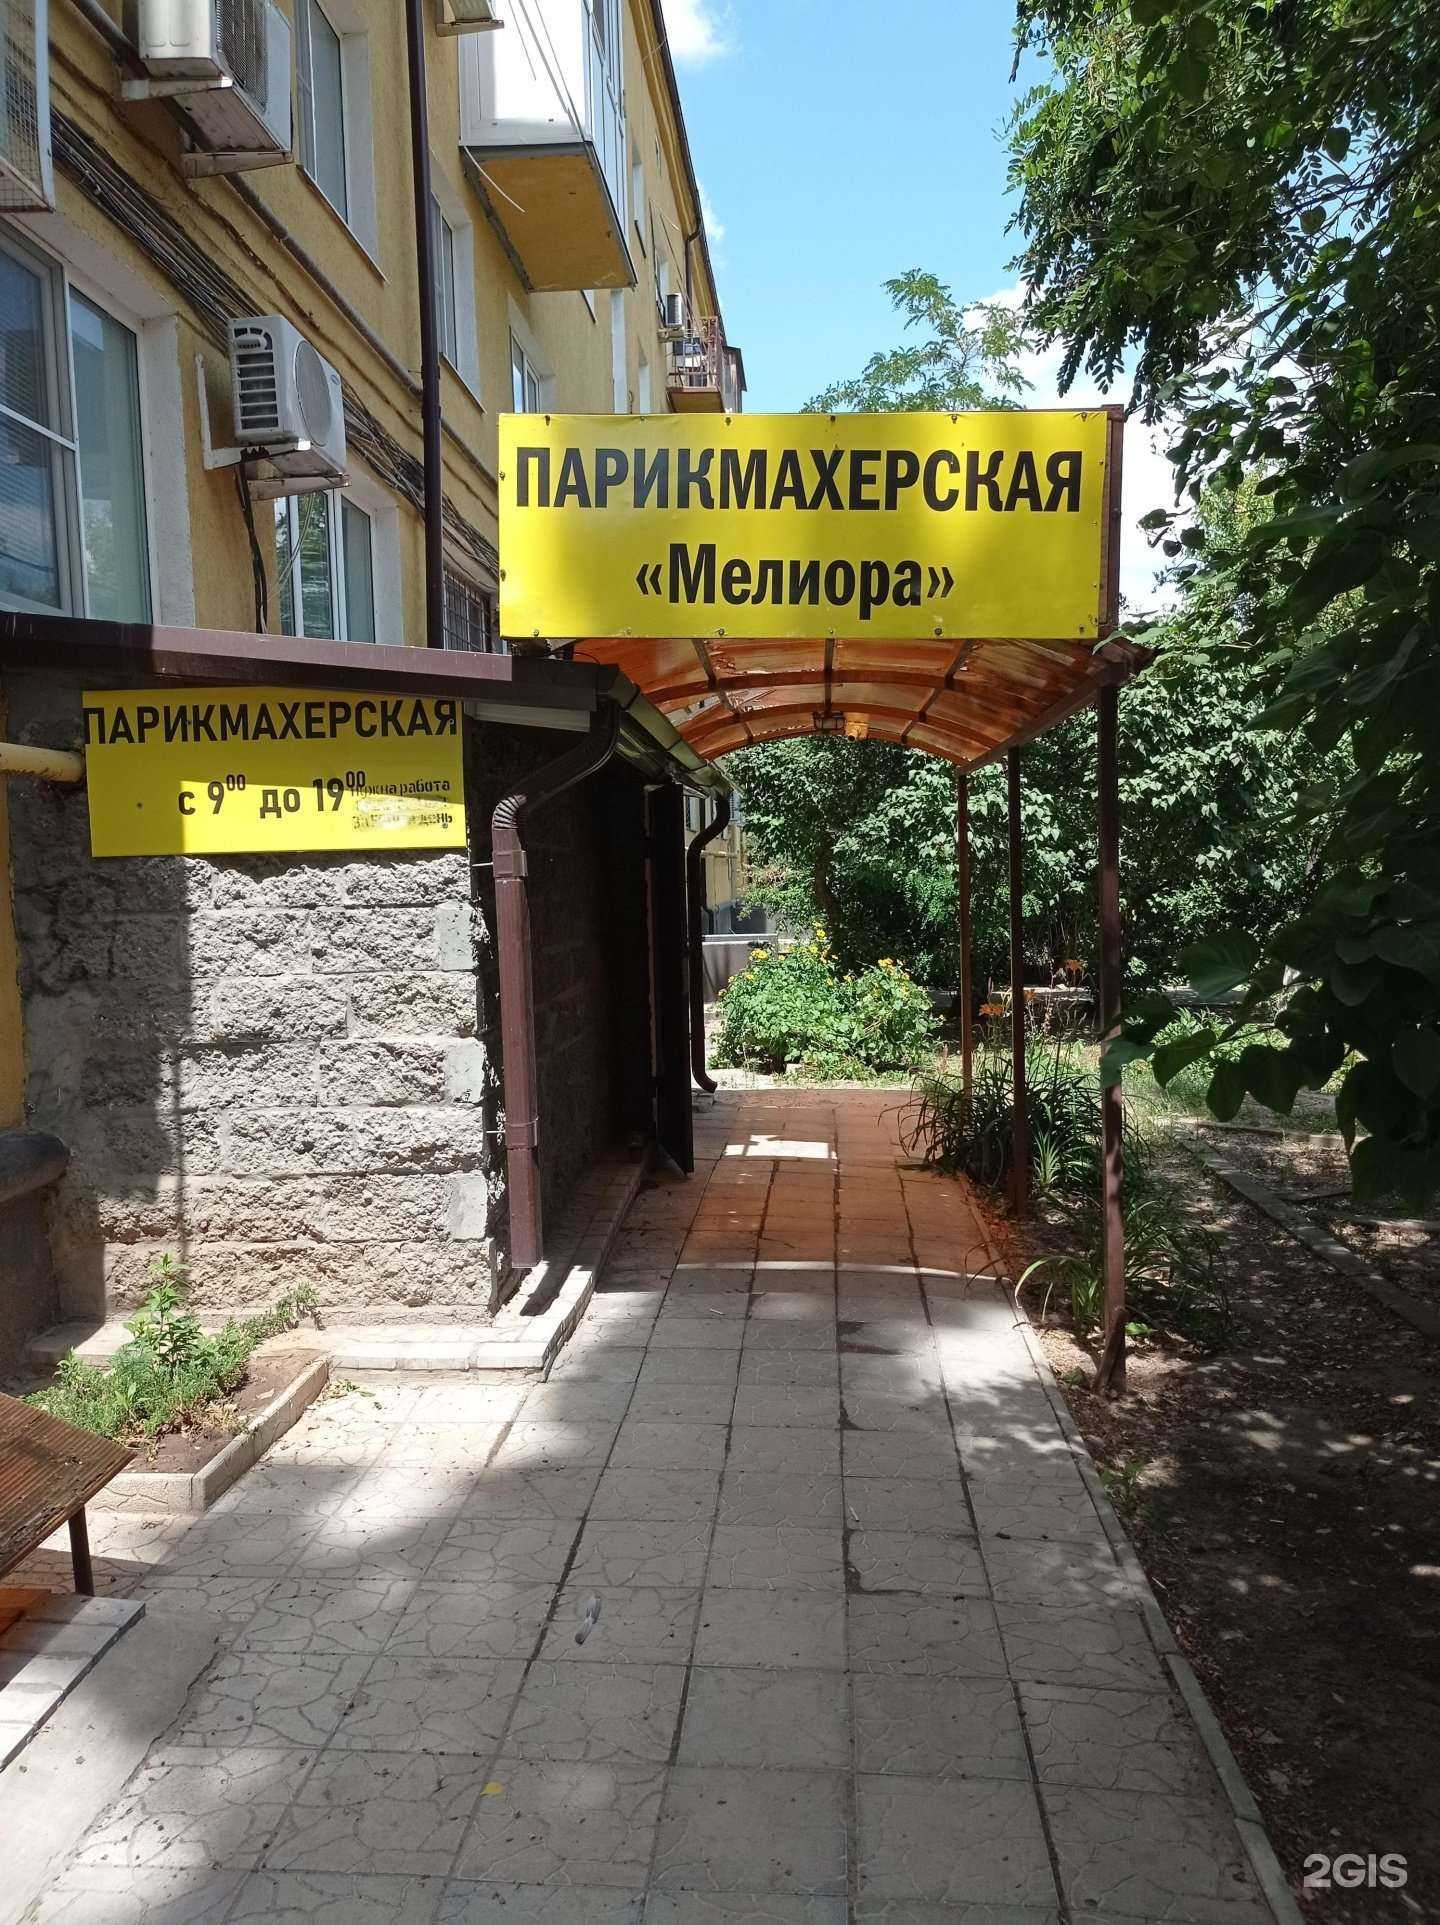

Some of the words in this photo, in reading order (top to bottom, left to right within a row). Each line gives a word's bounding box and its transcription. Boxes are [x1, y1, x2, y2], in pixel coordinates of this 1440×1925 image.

[516, 447, 1083, 512] ПАРИКМАХЕРСКАЯ
[635, 543, 955, 619] «Мелиора»
[83, 700, 457, 745] ПАРИКМАХЕРСКАЯ
[259, 788, 301, 819] до
